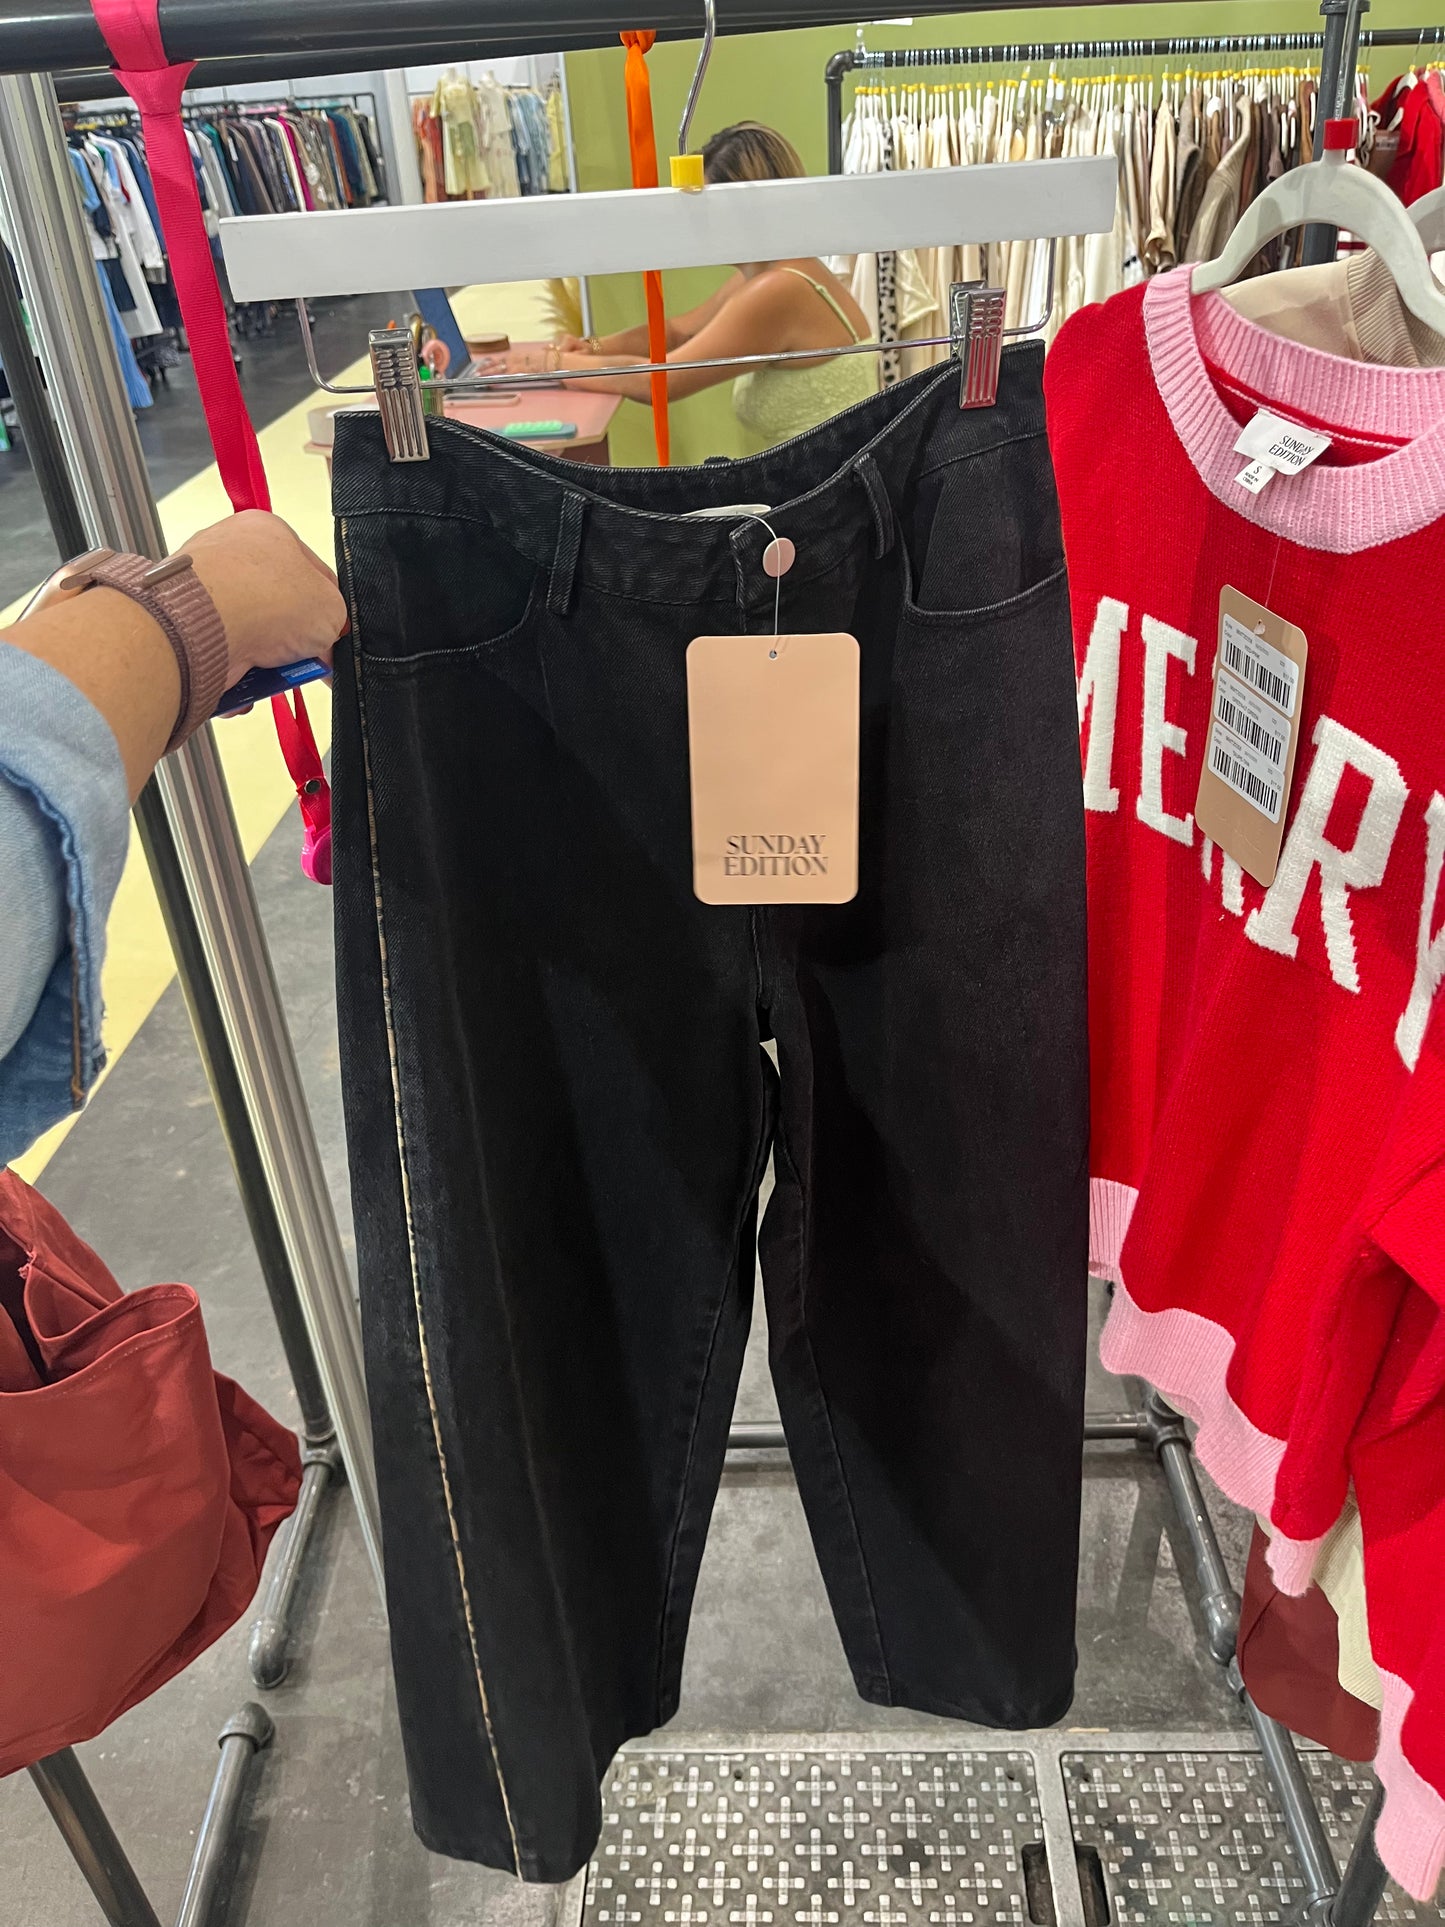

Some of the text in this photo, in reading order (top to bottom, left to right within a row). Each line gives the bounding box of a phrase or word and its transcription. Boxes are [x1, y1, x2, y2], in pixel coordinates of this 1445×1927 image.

[1268, 444, 1306, 466] EDITION
[1279, 435, 1314, 455] SUNDAY
[1253, 465, 1263, 475] S
[726, 834, 826, 855] SUNDAY
[724, 855, 829, 876] EDITION
